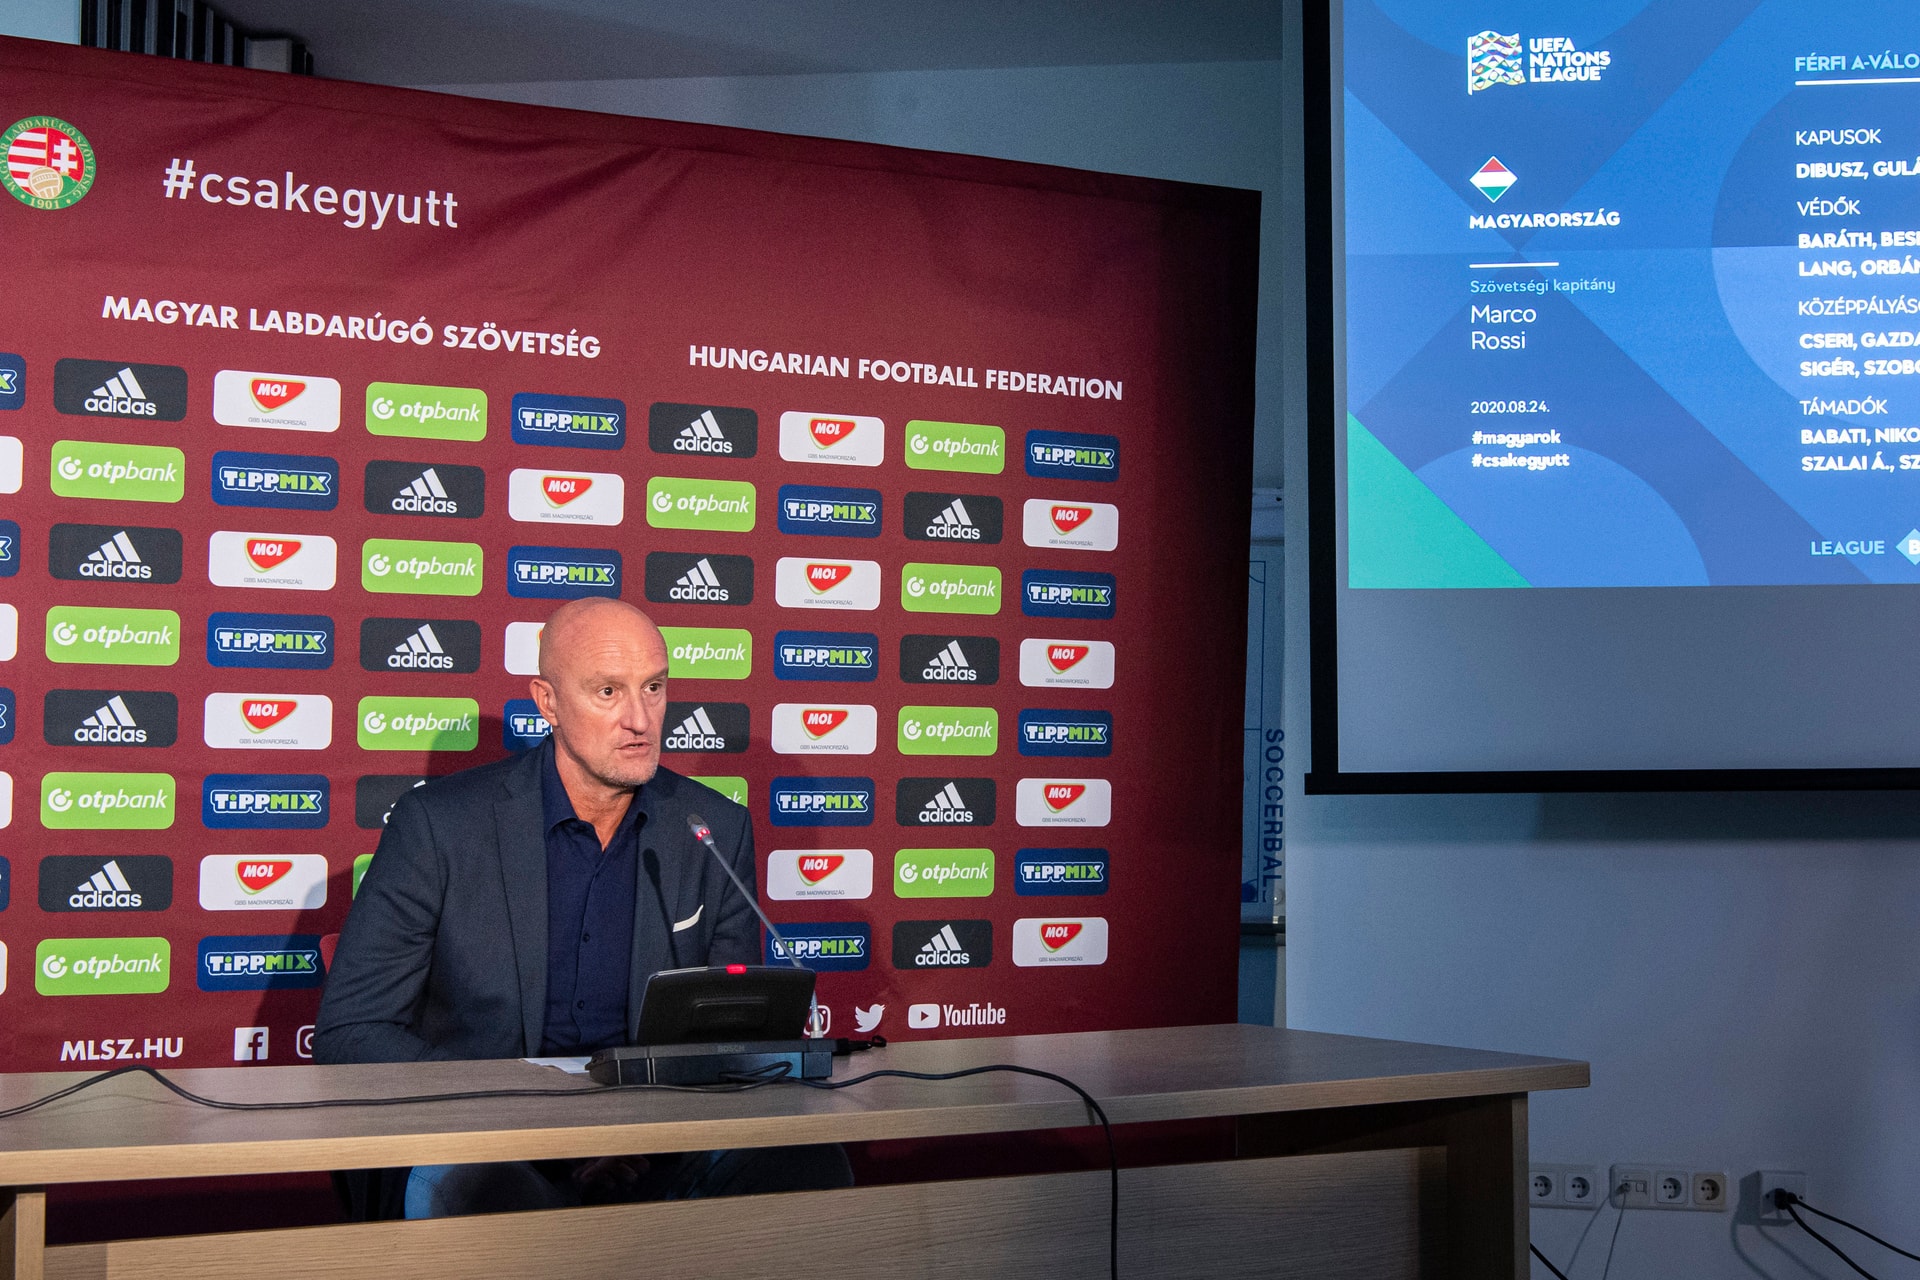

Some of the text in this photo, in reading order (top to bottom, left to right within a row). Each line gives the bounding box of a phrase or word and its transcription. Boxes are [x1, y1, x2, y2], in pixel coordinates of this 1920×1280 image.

[1529, 37, 1576, 53] UEFA
[1529, 50, 1611, 68] NATIONS
[1795, 52, 1846, 72] FÉRFI
[1529, 66, 1602, 83] LEAGUE
[1795, 128, 1882, 146] KAPUSOK
[1796, 161, 1869, 180] DIBUSZ,
[30, 197, 60, 210] 1901
[163, 158, 458, 231] #csakegyutt
[1796, 196, 1861, 217] VÉDŐK
[1469, 208, 1621, 230] MAGYARORSZÁG
[1798, 228, 1878, 251] BARÁTH,
[1798, 259, 1858, 279] LANG,
[1470, 276, 1616, 298] Szövetségi kapitány
[1470, 304, 1537, 324] Marco
[1798, 294, 1920, 317] KÖZÉPPÁLYÁS
[101, 295, 601, 359] MAGYAR LABDARÚGÓ SZÖVETSÉG
[1471, 330, 1526, 350] Rossi
[1798, 332, 1859, 351] CSERI,
[689, 344, 1123, 401] HUNGARIAN FOOTBALL FEDERATION
[1799, 356, 1861, 379] SIGÉR,
[256, 382, 288, 398] MOL
[85, 396, 156, 415] adidas
[399, 401, 480, 424] otpbank
[1470, 399, 1550, 415] 2020.08.24.
[1799, 395, 1889, 416] TÁMADÓK
[814, 422, 841, 436] MOL
[1471, 429, 1561, 447] #magyarok
[1800, 428, 1872, 447] BABATI,
[674, 437, 732, 453] adidas
[933, 437, 998, 457] otpbank
[86, 460, 176, 483] otpbank
[1471, 452, 1570, 472] #csakegyutt
[1801, 455, 1868, 472] SZALAI
[547, 479, 576, 495] MOL
[392, 495, 457, 513] adidas
[676, 494, 749, 516] otpbank
[1055, 509, 1079, 522] MOL
[926, 523, 980, 539] adidas
[252, 542, 284, 557] MOL
[1811, 540, 1885, 555] LEAGUE
[79, 559, 151, 578] adidas
[395, 557, 475, 579] otpbank
[810, 567, 837, 581] MOL
[670, 585, 728, 601] adidas
[929, 579, 995, 599] otpbank
[82, 625, 171, 648] otpbank
[388, 651, 453, 668] adidas
[672, 643, 744, 664] otpbank
[1051, 647, 1075, 661] MOL
[923, 666, 976, 680] adidas
[247, 703, 279, 717] MOL
[807, 712, 833, 726] MOL
[75, 725, 147, 742] adidas
[391, 714, 471, 736] otpbank
[926, 720, 991, 741] otpbank
[666, 735, 724, 749] adidas
[78, 789, 166, 813] otpbank
[1048, 787, 1072, 799] MOL
[919, 808, 973, 822] adidas
[243, 864, 274, 878] MOL
[802, 858, 829, 871] MOL
[921, 863, 987, 883] otpbank
[69, 891, 141, 907] adidas
[1045, 926, 1069, 939] MOL
[72, 954, 161, 979] otpbank
[915, 950, 969, 965] adidas
[942, 1002, 1006, 1026] YouTube
[60, 1037, 184, 1062] MLSZ.HU
